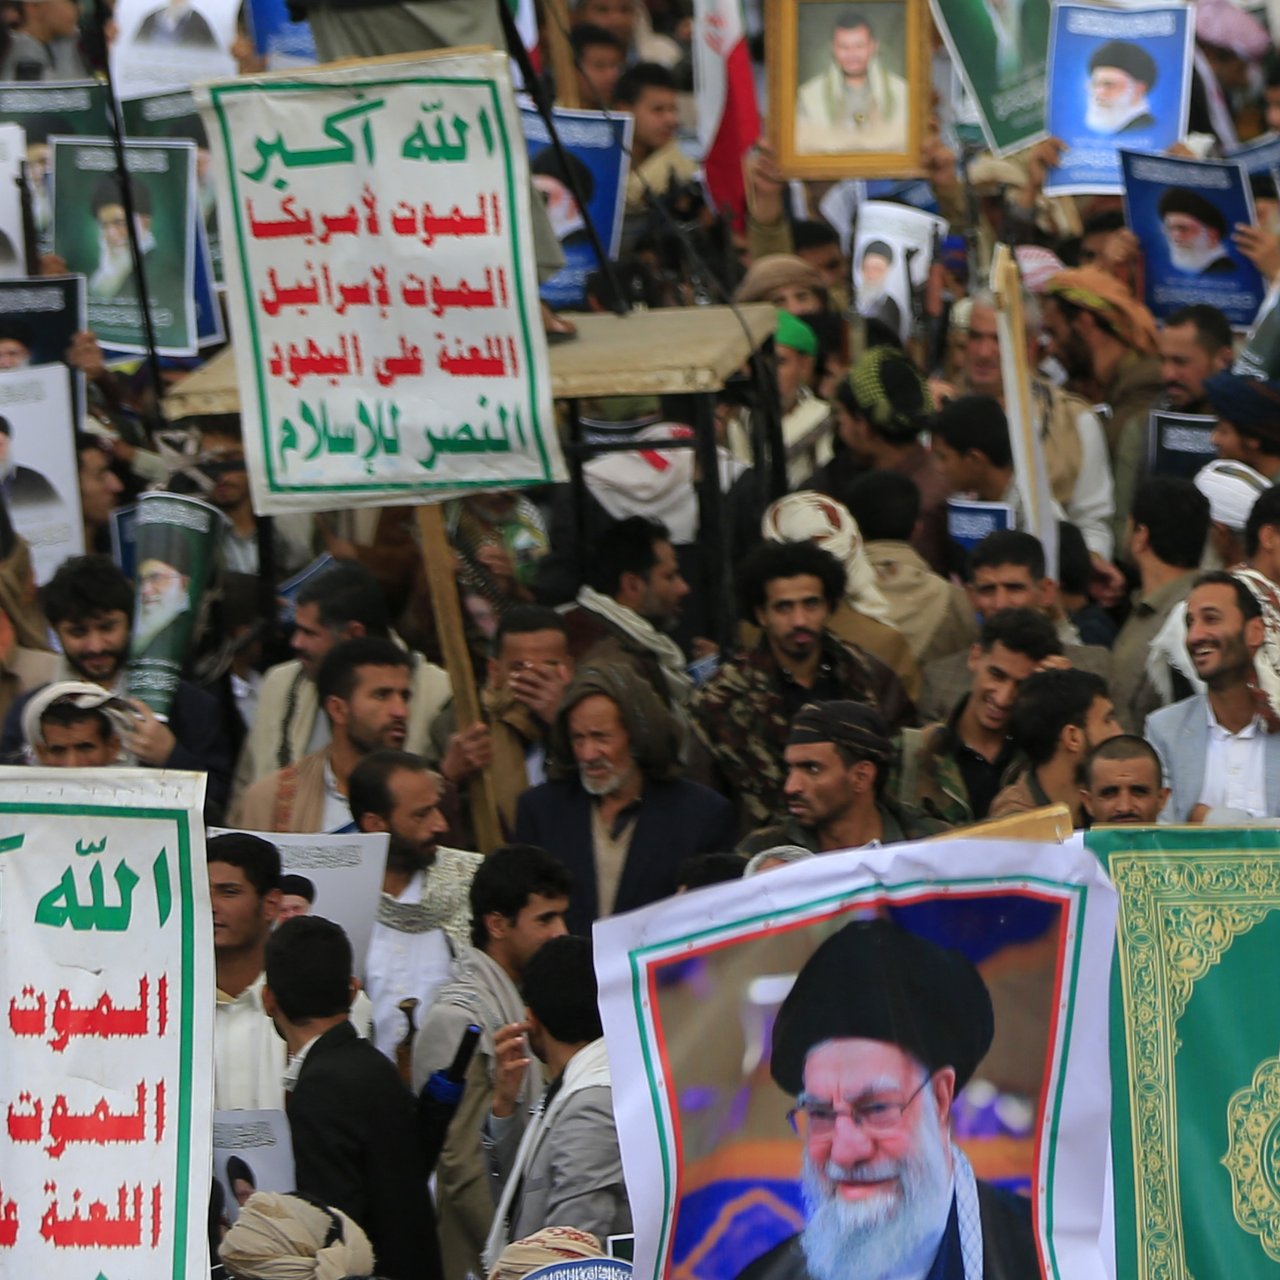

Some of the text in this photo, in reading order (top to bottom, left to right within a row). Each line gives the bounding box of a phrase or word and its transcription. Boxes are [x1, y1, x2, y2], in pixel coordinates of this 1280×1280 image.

[240, 92, 495, 191] الله أكبر
[246, 183, 501, 248] الموت لأمريكا
[260, 260, 509, 319] الموت لإسرائيل
[267, 332, 519, 390] اللعنة على اليهود
[279, 393, 528, 476] النصر للإسلام
[35, 837, 173, 932] الله
[9, 973, 169, 1053] الموت
[7, 1078, 167, 1160] الموت
[40, 1180, 162, 1250] اللعنة
